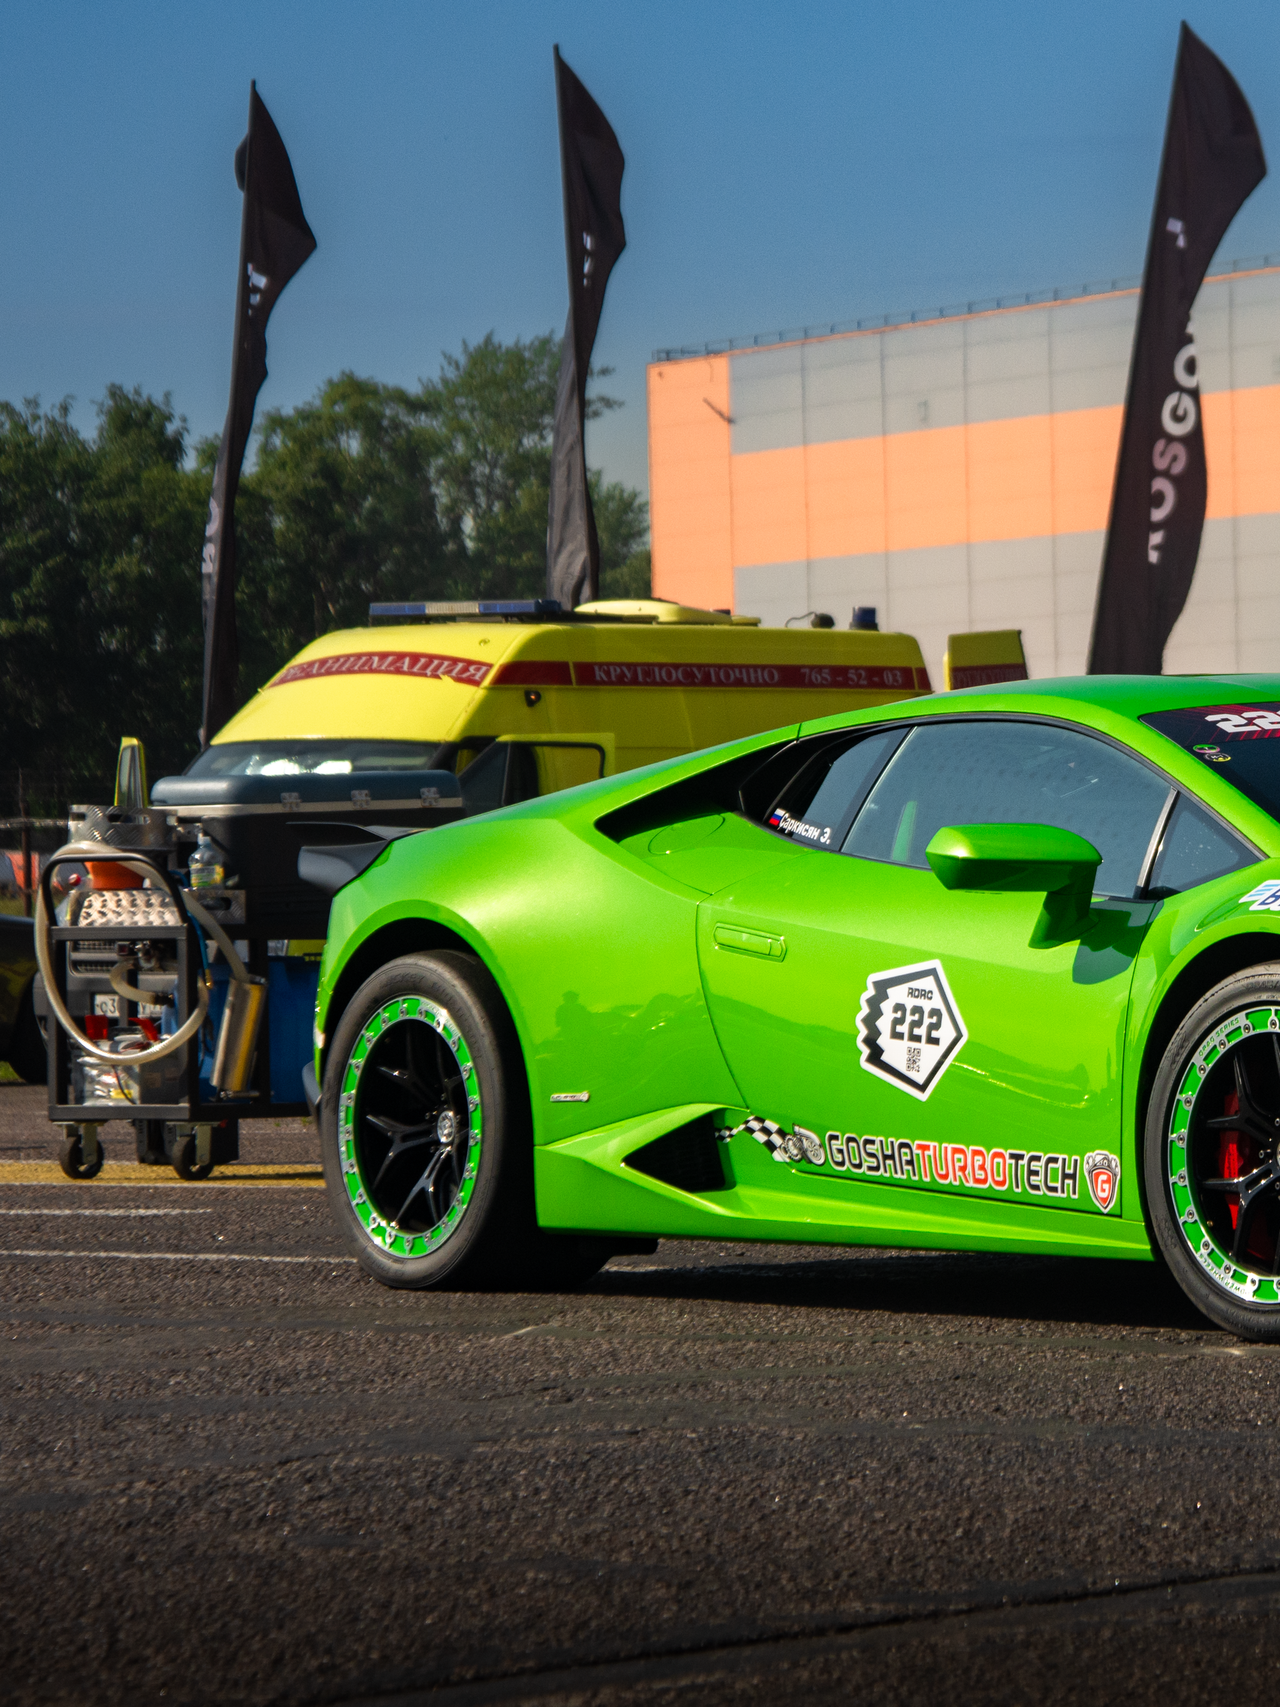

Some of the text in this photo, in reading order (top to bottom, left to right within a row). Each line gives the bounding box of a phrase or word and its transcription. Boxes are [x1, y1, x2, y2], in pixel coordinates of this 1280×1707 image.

[593, 664, 780, 684] КРУГЛОСУТОЧНО
[801, 668, 831, 685] 765
[847, 669, 868, 685] 52
[883, 669, 903, 686] 03
[779, 813, 821, 840] Саркисян
[907, 987, 933, 1000] RDRC
[889, 1003, 943, 1046] 222
[827, 1131, 1079, 1198] GOSHATURBOTECH
